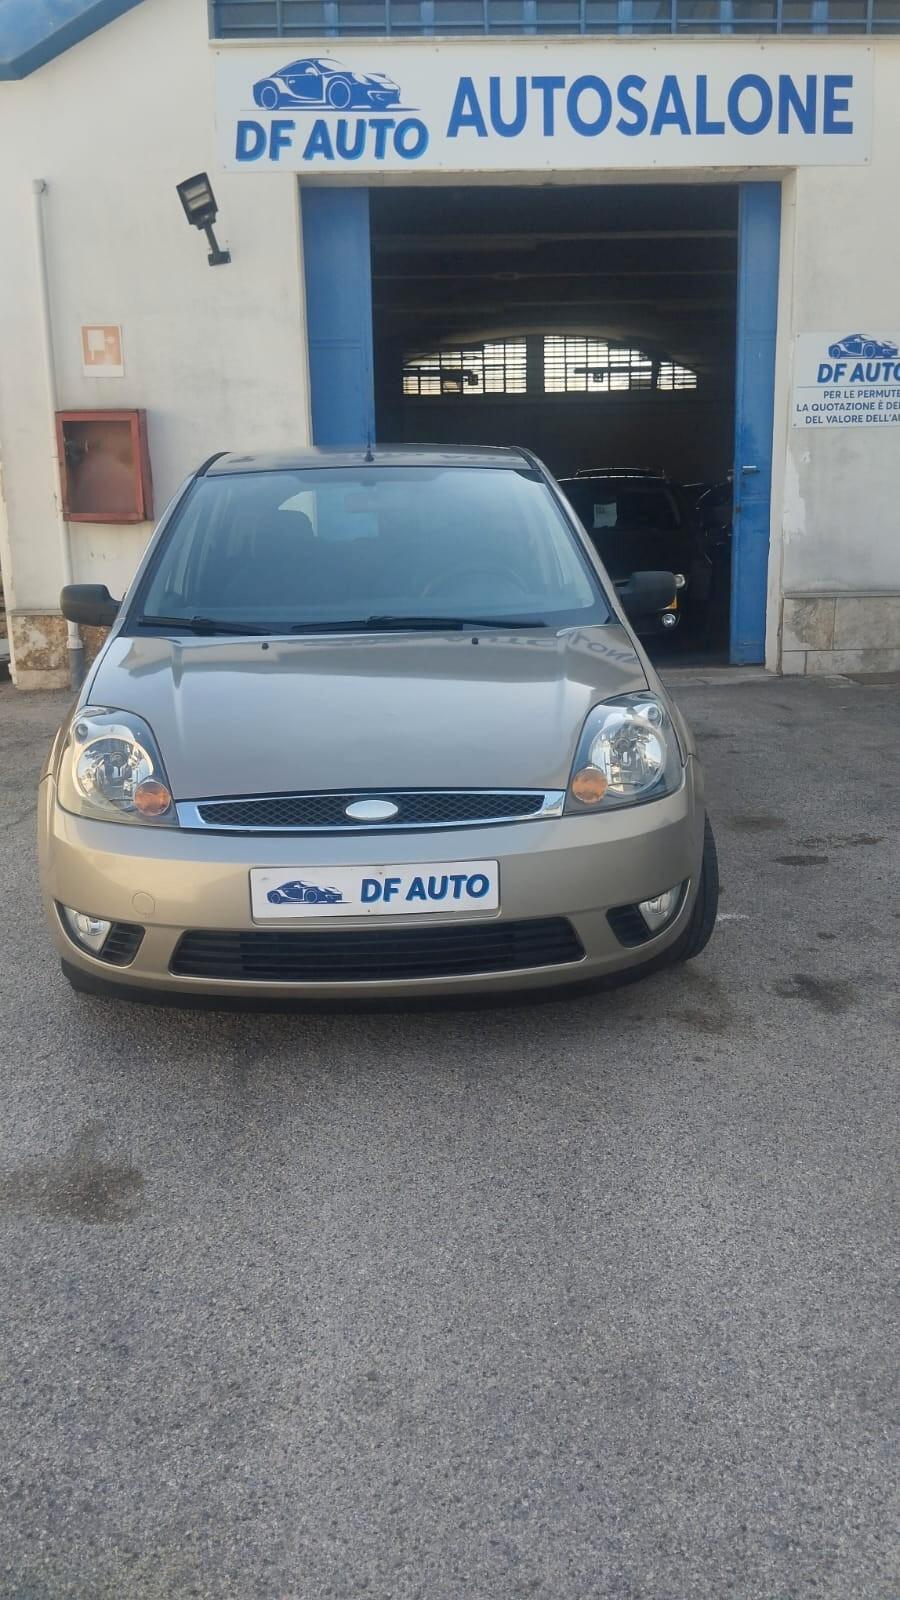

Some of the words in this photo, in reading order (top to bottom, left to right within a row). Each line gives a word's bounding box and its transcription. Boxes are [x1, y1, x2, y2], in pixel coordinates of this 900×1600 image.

[446, 73, 853, 138] AUTOSALONE
[235, 119, 295, 162] DF
[302, 117, 429, 160] AUTO
[817, 363, 847, 384] DF
[823, 390, 842, 399] PER
[844, 390, 855, 399] LE
[796, 403, 809, 412] LA
[811, 402, 875, 412] QUOTAZIONE
[878, 400, 884, 410] È
[886, 401, 900, 410] DE
[805, 415, 823, 424] DEL
[826, 414, 864, 424] VALORE
[360, 878, 402, 904] DF
[405, 873, 490, 901] AUTO
